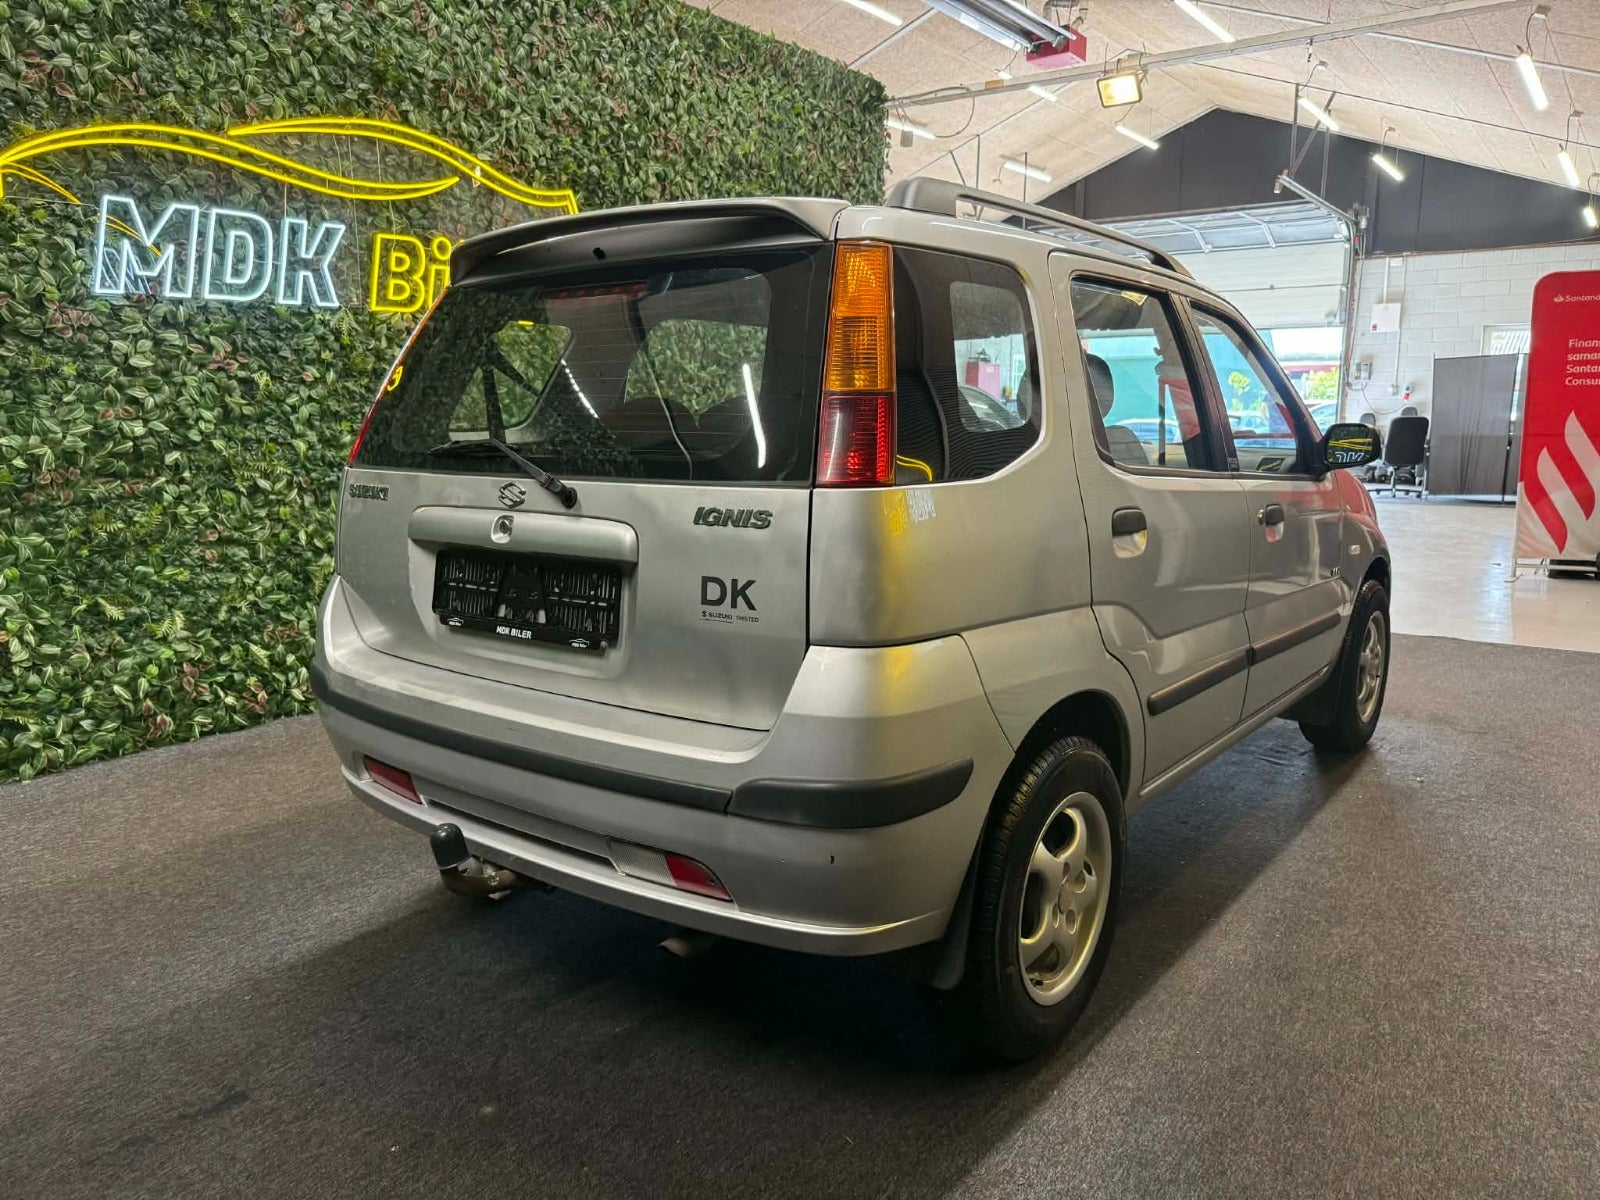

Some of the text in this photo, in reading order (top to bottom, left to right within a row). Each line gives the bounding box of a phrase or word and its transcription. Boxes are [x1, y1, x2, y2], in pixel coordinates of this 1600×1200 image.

[94, 194, 452, 313] MDK Bi
[1568, 338, 1600, 348] Finan
[1565, 376, 1600, 386] Consu
[693, 506, 773, 530] IGNIS
[701, 575, 757, 611] DK
[510, 627, 532, 639] BILER
